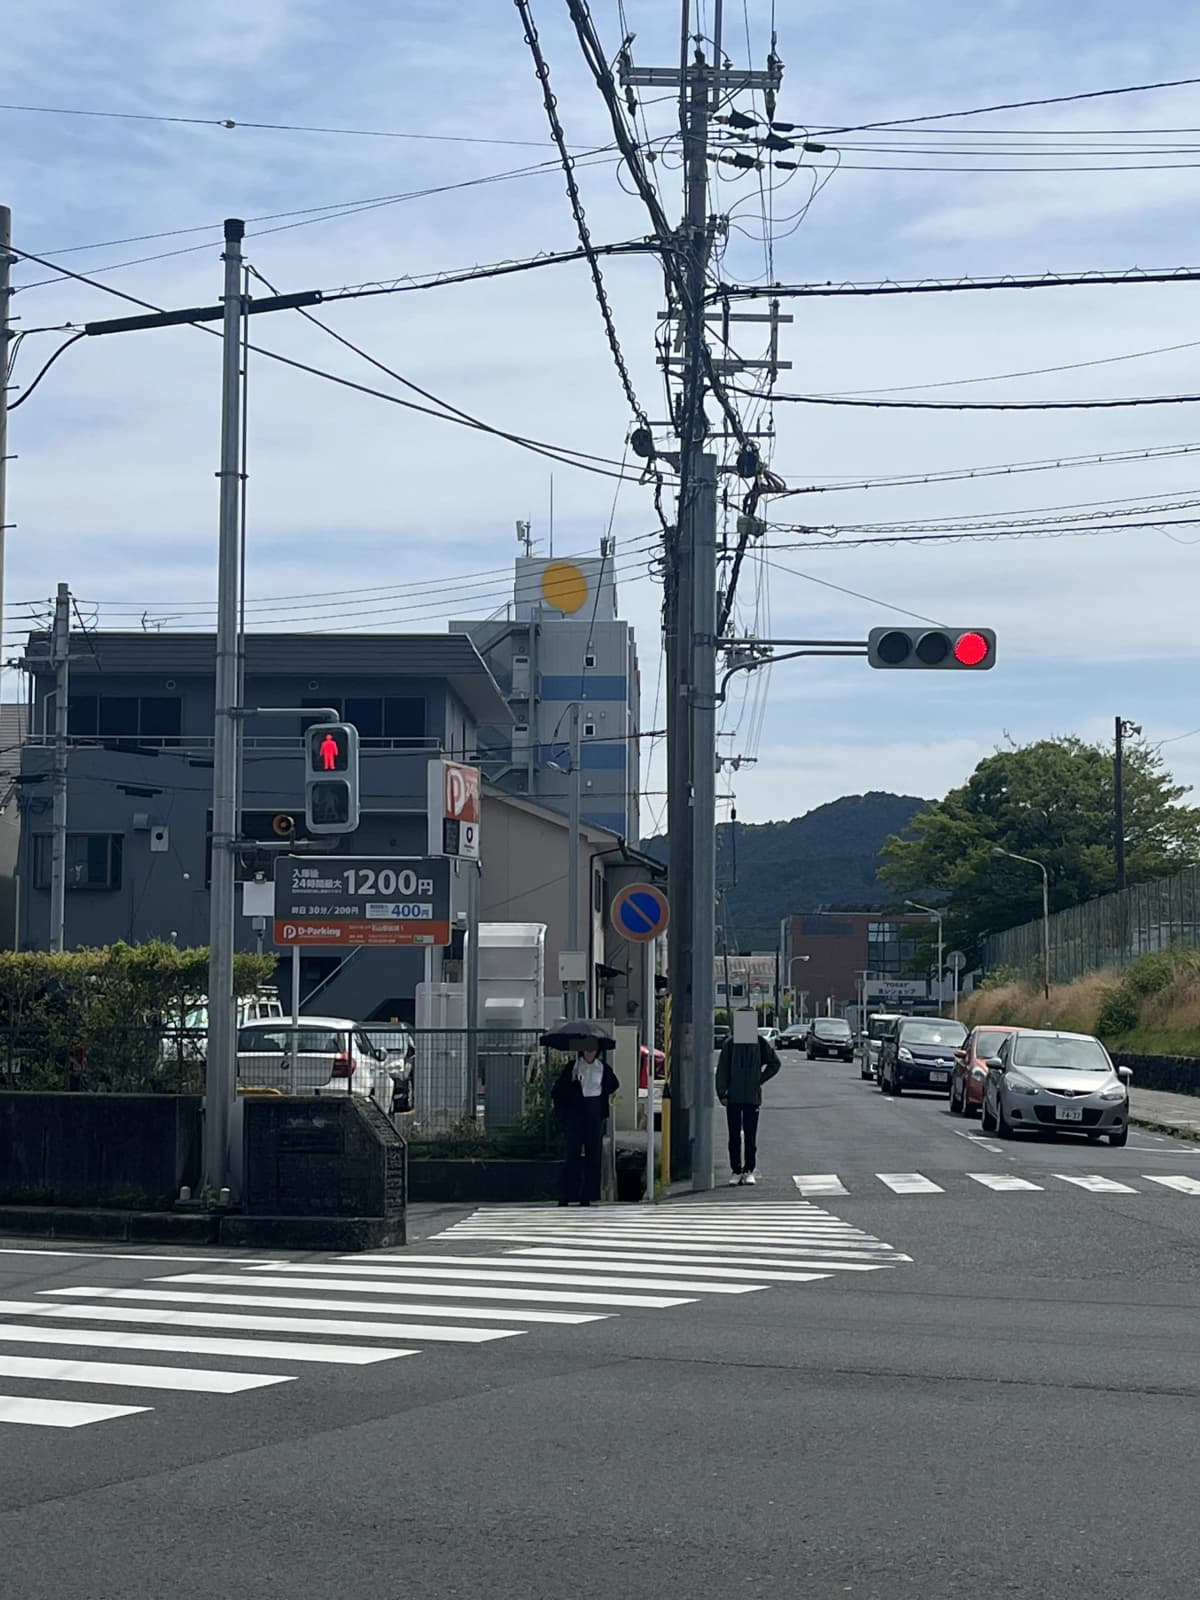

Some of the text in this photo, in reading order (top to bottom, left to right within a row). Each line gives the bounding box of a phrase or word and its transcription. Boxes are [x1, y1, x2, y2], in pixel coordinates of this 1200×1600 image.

[343, 869, 434, 895] 1200円
[392, 904, 430, 918] 400円
[298, 926, 341, 937] D-Parking
